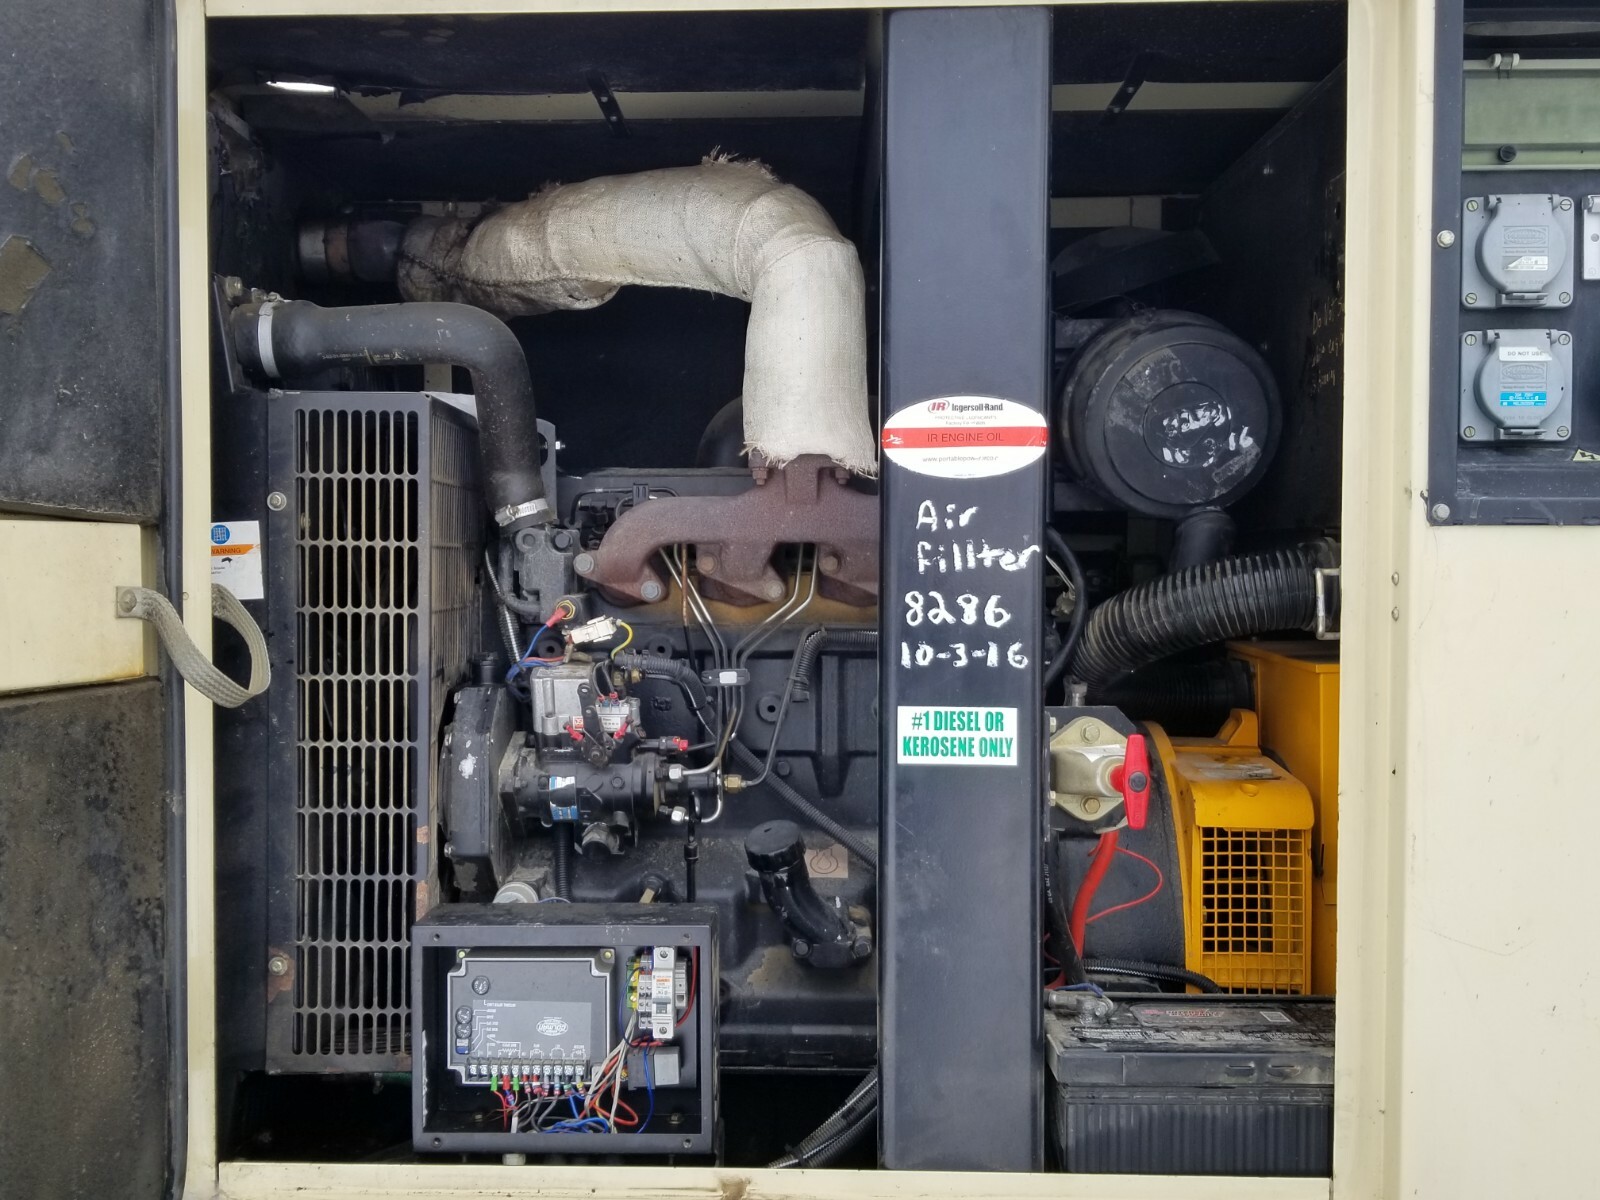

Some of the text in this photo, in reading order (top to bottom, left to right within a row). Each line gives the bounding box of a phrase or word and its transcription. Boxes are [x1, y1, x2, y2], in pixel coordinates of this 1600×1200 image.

[928, 432, 1004, 442] IR ENGINE OIL
[916, 500, 979, 532] Air
[904, 590, 1012, 628] 8286
[912, 711, 1004, 731] #1 DIESEL OR
[903, 736, 1013, 758] KEROSENE ONLY
